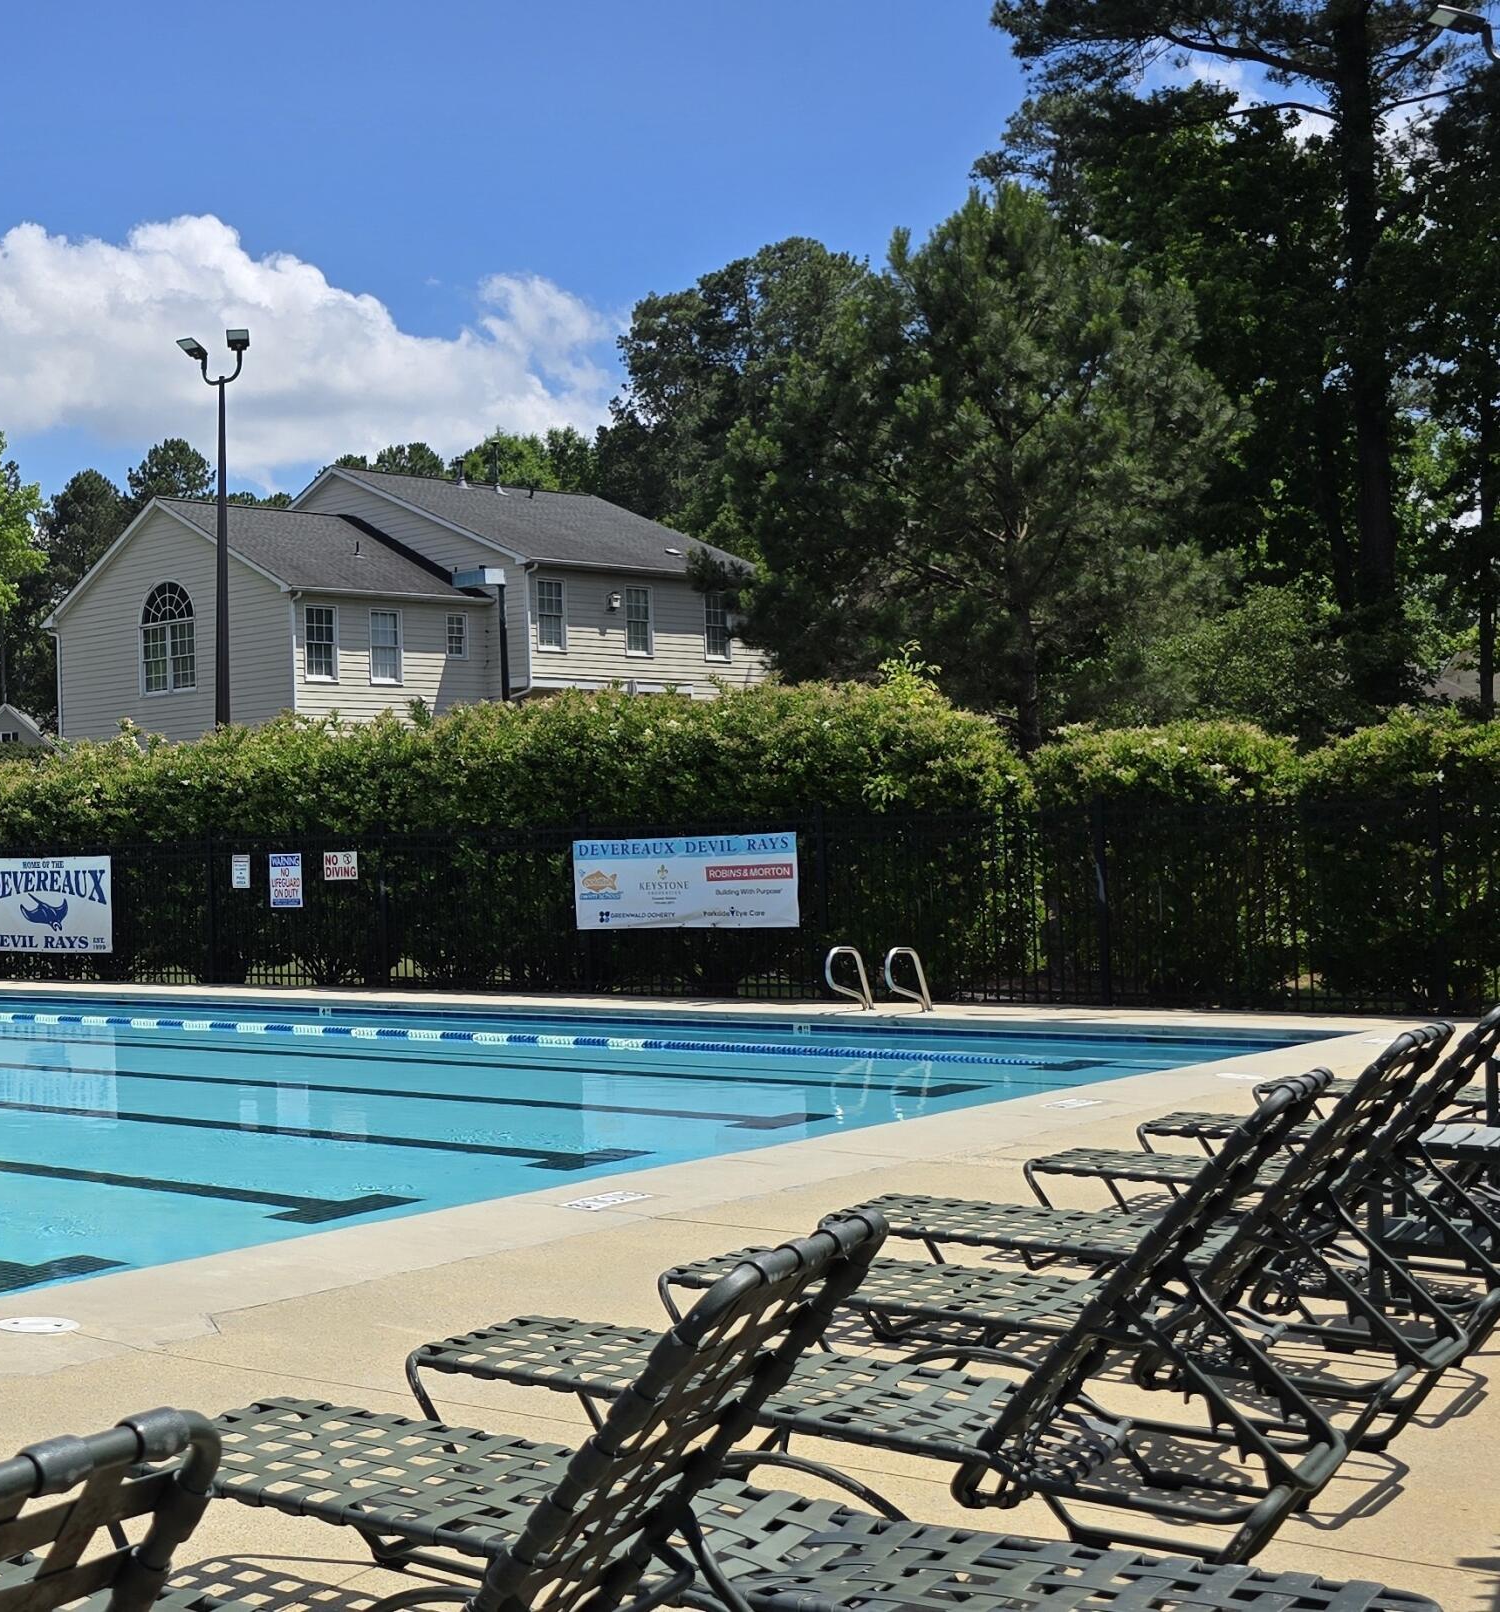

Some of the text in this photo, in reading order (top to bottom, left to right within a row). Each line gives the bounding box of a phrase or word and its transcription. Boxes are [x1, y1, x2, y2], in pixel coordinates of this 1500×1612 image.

[579, 837, 789, 857] DEVEREAUX DEVIL RAYS
[22, 861, 41, 869] HOME
[51, 860, 64, 868] THE
[271, 856, 300, 867] WARNING
[325, 855, 338, 865] NO
[280, 867, 290, 877] NO
[325, 866, 357, 878] DIVING
[708, 866, 791, 878] ROBINS & MORTON
[271, 878, 301, 888] LIFEGUARD
[639, 880, 689, 890] KEYSTONE
[273, 888, 299, 899] ON DUTY
[715, 888, 739, 896] Building
[44, 935, 89, 949] RAYS
